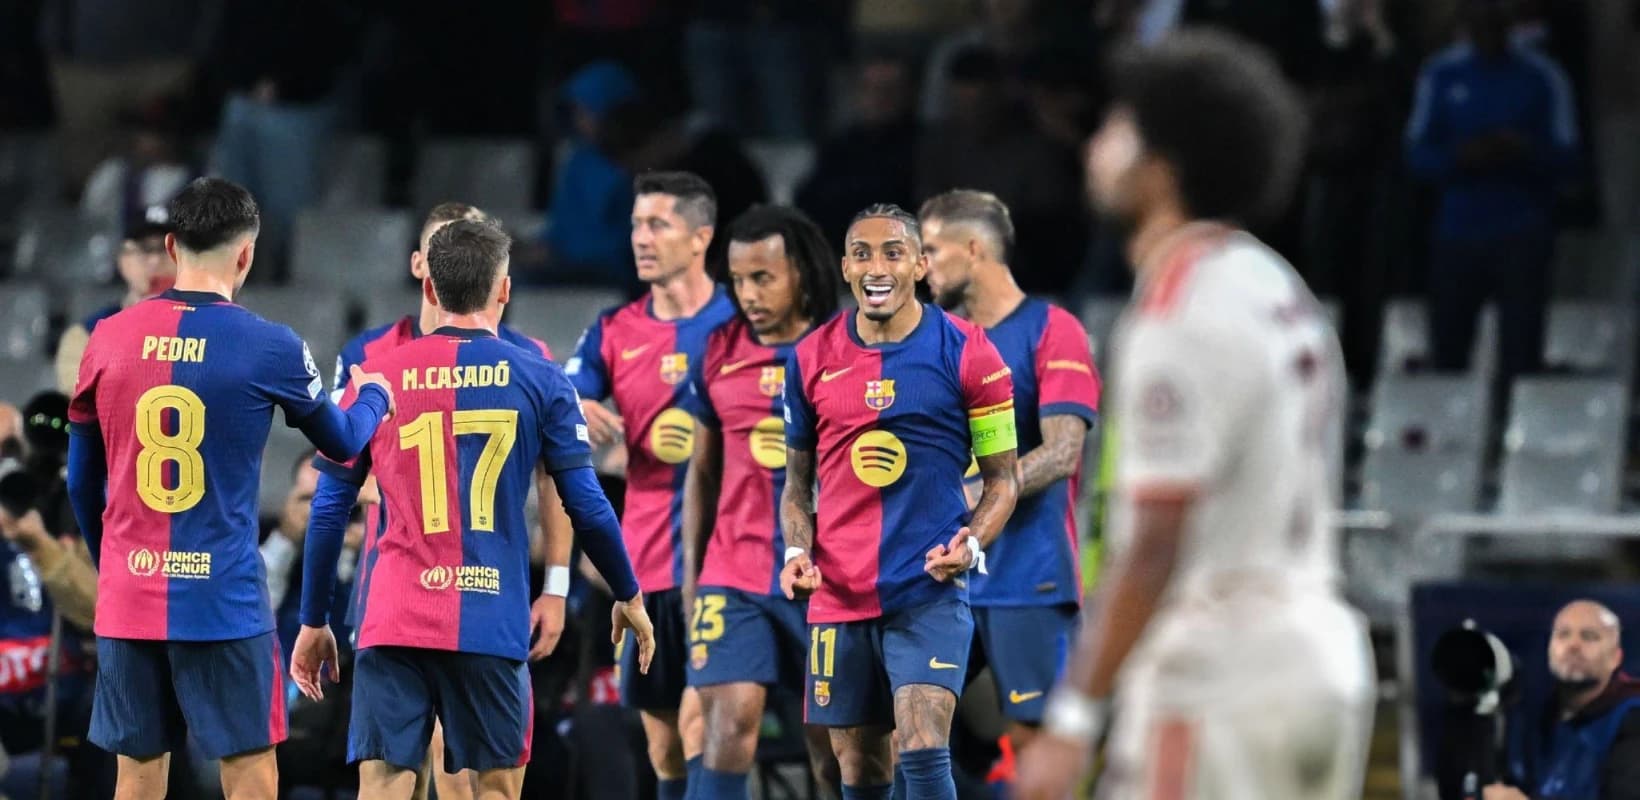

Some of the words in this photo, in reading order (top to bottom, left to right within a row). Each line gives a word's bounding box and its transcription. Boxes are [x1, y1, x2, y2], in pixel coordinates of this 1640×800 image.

[142, 336, 206, 363] PEDRI
[402, 360, 510, 391] M.CASADÓ
[136, 385, 206, 513] 8
[399, 409, 518, 534] 17
[161, 562, 210, 574] ACNUR
[163, 551, 211, 563] UNHCR
[454, 577, 499, 590] ACNUR
[455, 566, 499, 580] UNHCR
[811, 627, 836, 677] 11
